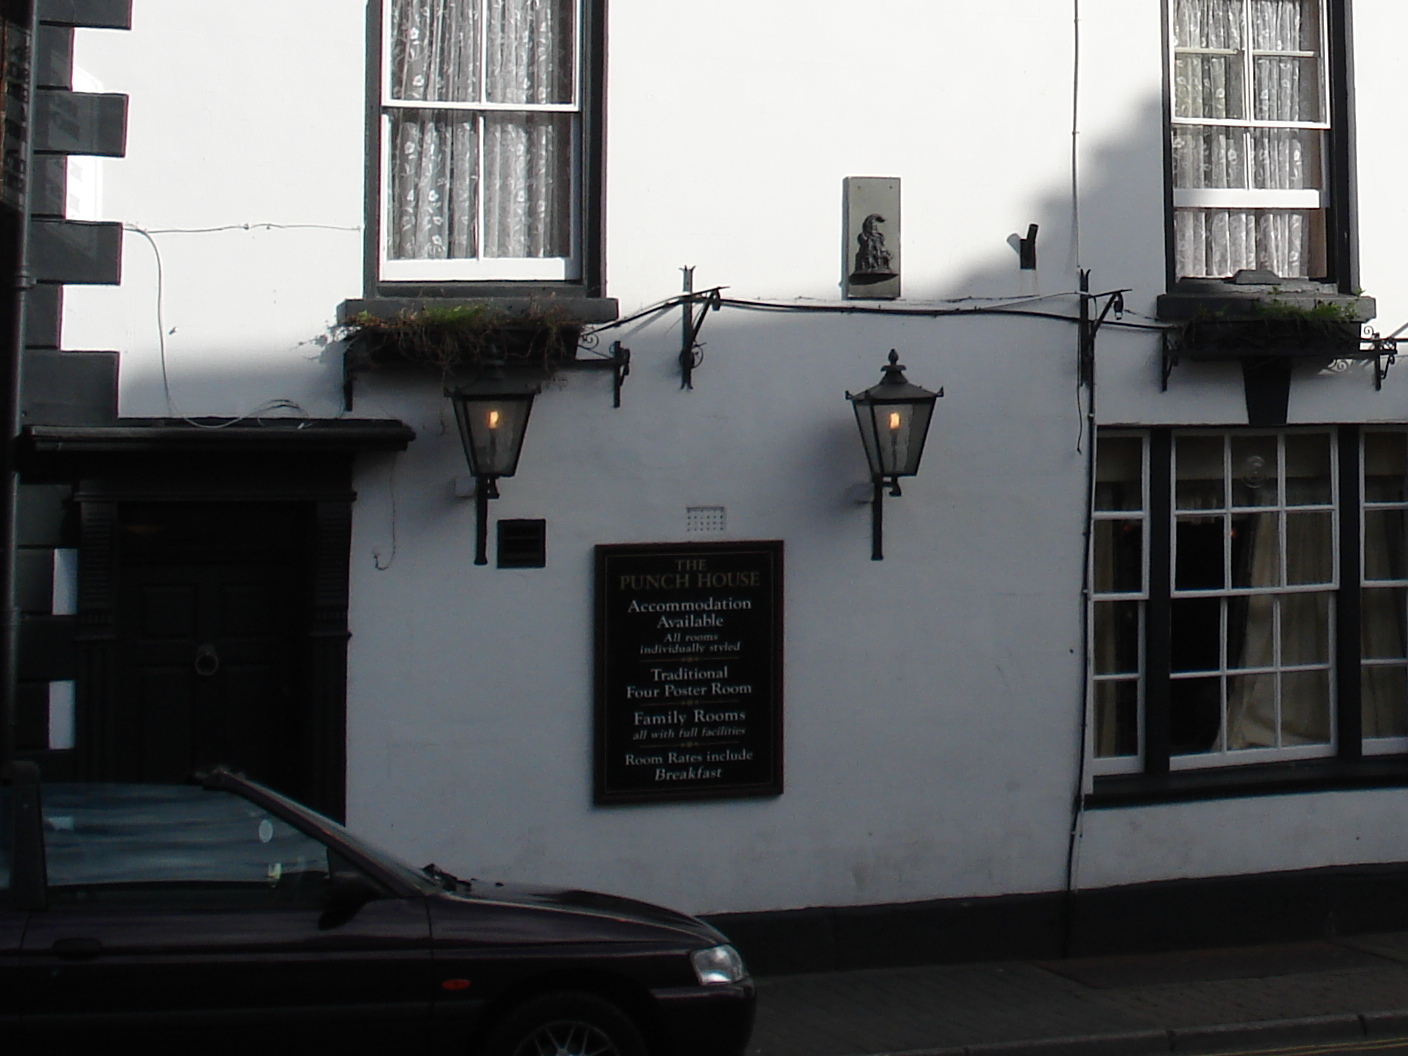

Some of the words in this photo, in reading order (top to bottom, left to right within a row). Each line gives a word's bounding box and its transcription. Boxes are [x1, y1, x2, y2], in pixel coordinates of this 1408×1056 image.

[674, 559, 708, 572] THE
[620, 573, 690, 591] PUNCH
[697, 571, 760, 588] HOUSE
[628, 596, 752, 613] Accommodation
[657, 613, 724, 629] Available
[664, 632, 681, 643] All
[685, 634, 719, 643] rooms
[640, 643, 706, 655] individually
[709, 641, 741, 653] styled
[650, 665, 728, 682] Traditional
[626, 685, 660, 699] Four
[664, 684, 708, 697] Poster
[711, 682, 752, 695] Room
[634, 710, 687, 726] Family
[693, 709, 746, 723] Rooms
[632, 729, 648, 740] all
[650, 728, 675, 740] with
[678, 726, 699, 738] full
[701, 725, 746, 737] facilities
[624, 752, 663, 766] Room
[668, 750, 703, 764] Rates
[706, 748, 753, 762] include
[654, 766, 722, 781] Breakfast
